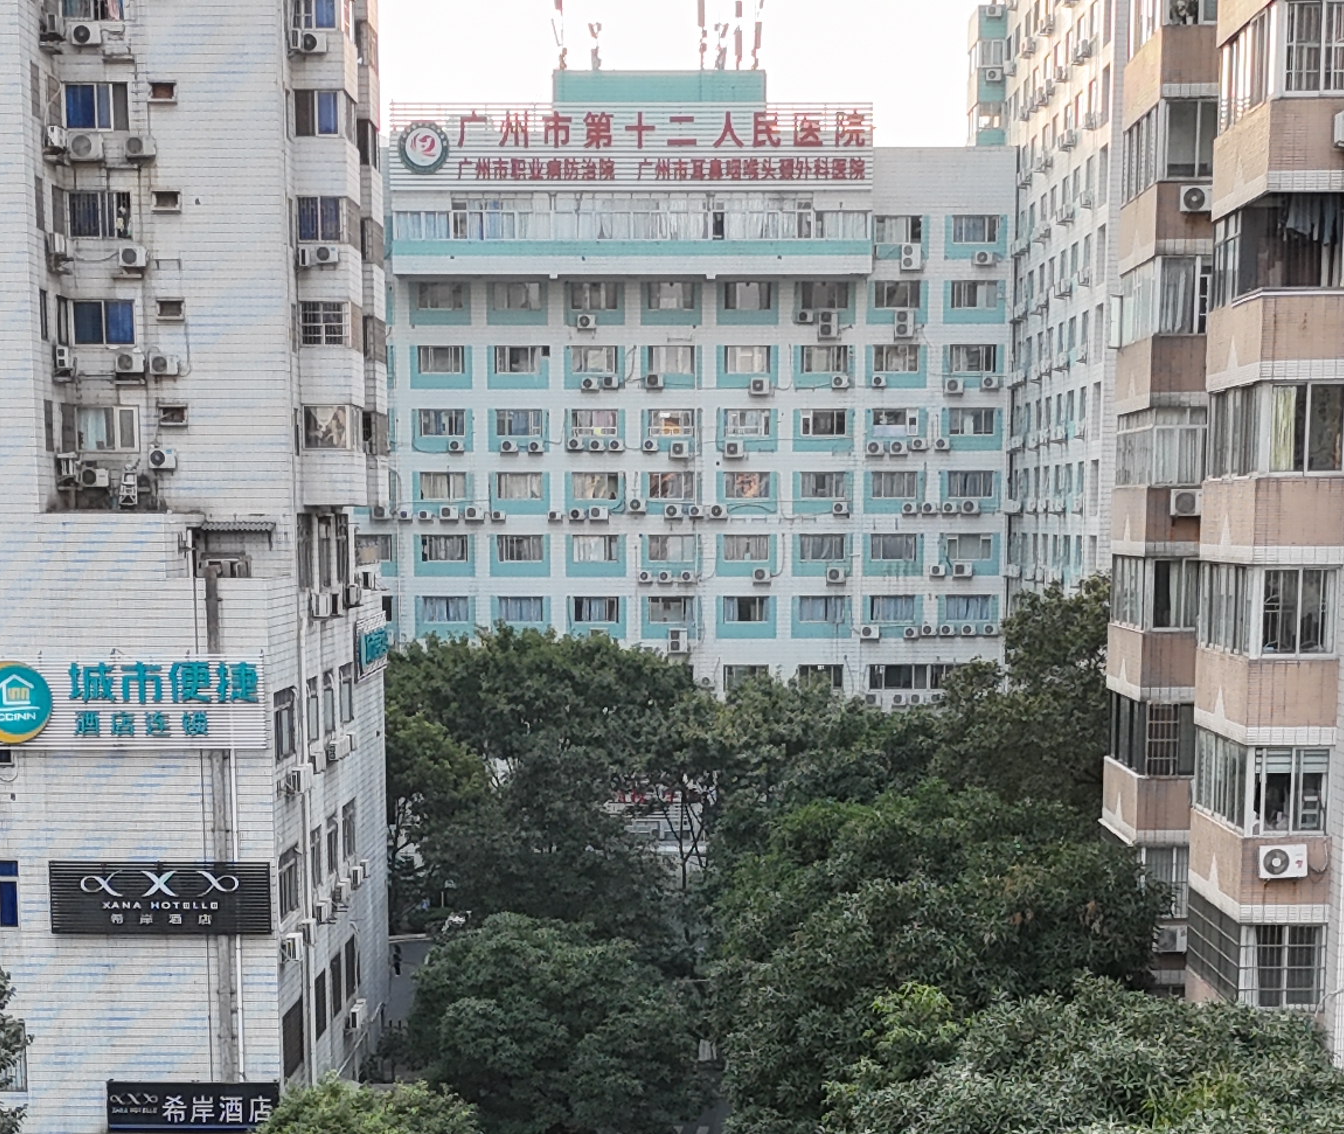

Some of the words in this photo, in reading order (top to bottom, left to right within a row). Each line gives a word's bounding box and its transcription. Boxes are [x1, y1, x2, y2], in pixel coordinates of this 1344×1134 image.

[456, 110, 866, 149] 广州市第十二人民医院
[457, 157, 616, 181] 广州市职业病防治院
[68, 660, 259, 704] 城市便捷
[74, 711, 209, 738] 酒店连锁
[102, 901, 142, 910] XANA
[110, 914, 213, 926] 希岸酒店
[162, 1095, 273, 1123] 希岸酒店
